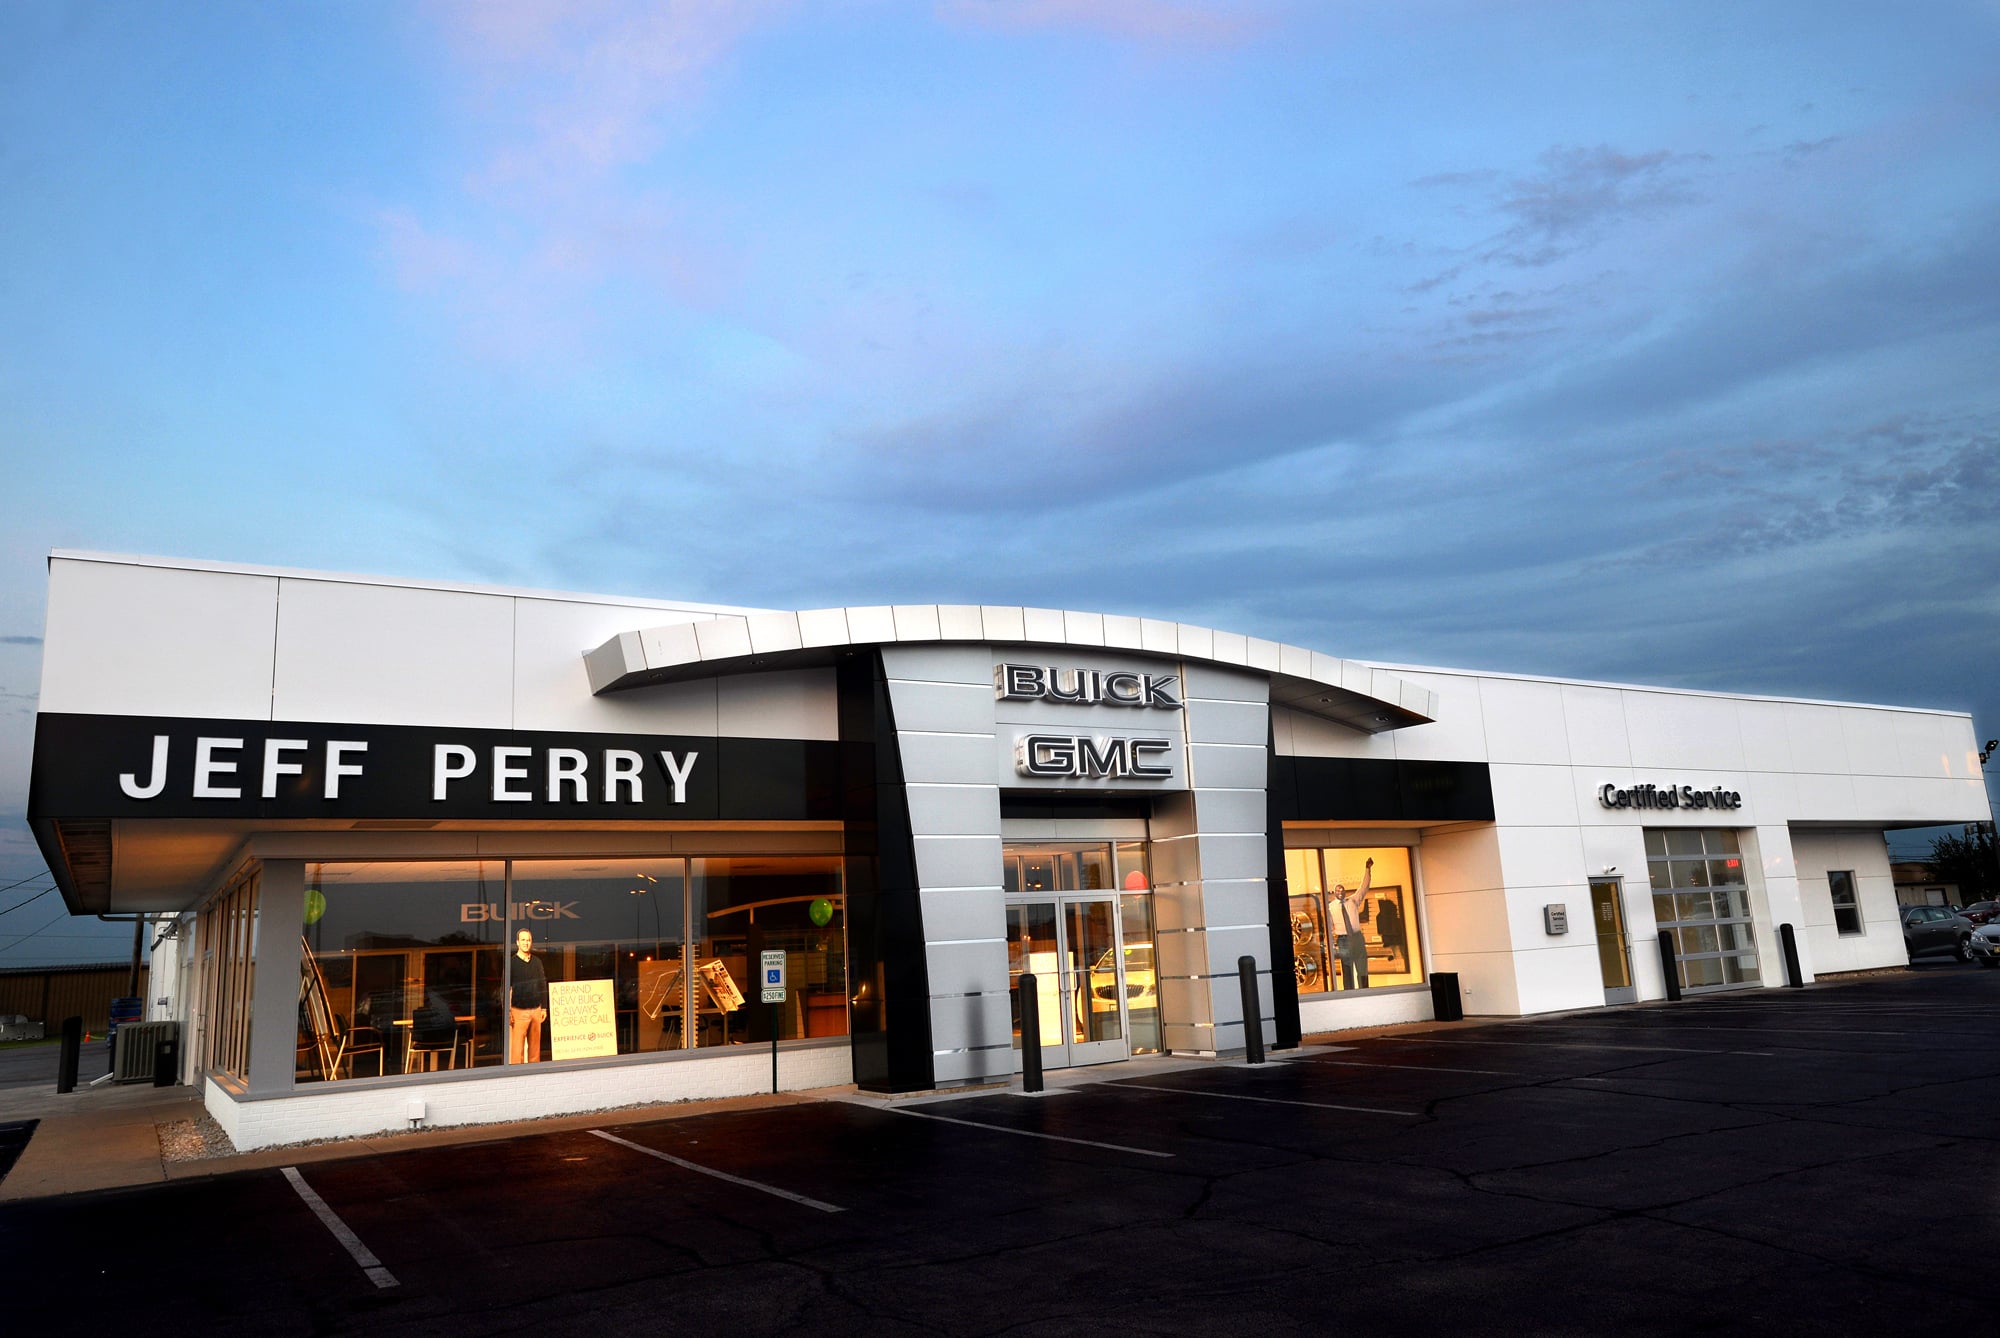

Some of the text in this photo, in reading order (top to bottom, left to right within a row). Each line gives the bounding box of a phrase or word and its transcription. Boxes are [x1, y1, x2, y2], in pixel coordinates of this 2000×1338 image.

[995, 663, 1184, 709] BUICK
[1016, 734, 1173, 778] GMC
[119, 735, 699, 803] JEFF PERRY
[1600, 783, 1742, 809] Certified Service
[461, 901, 581, 922] BUICK
[552, 984, 592, 996] A BRAND
[552, 994, 604, 1006] NEW BUICK
[552, 1004, 598, 1017] IS ALWAYS
[553, 1018, 560, 1027] A
[560, 1016, 588, 1027] GREAT
[554, 1034, 587, 1042] EXPERIENCE
